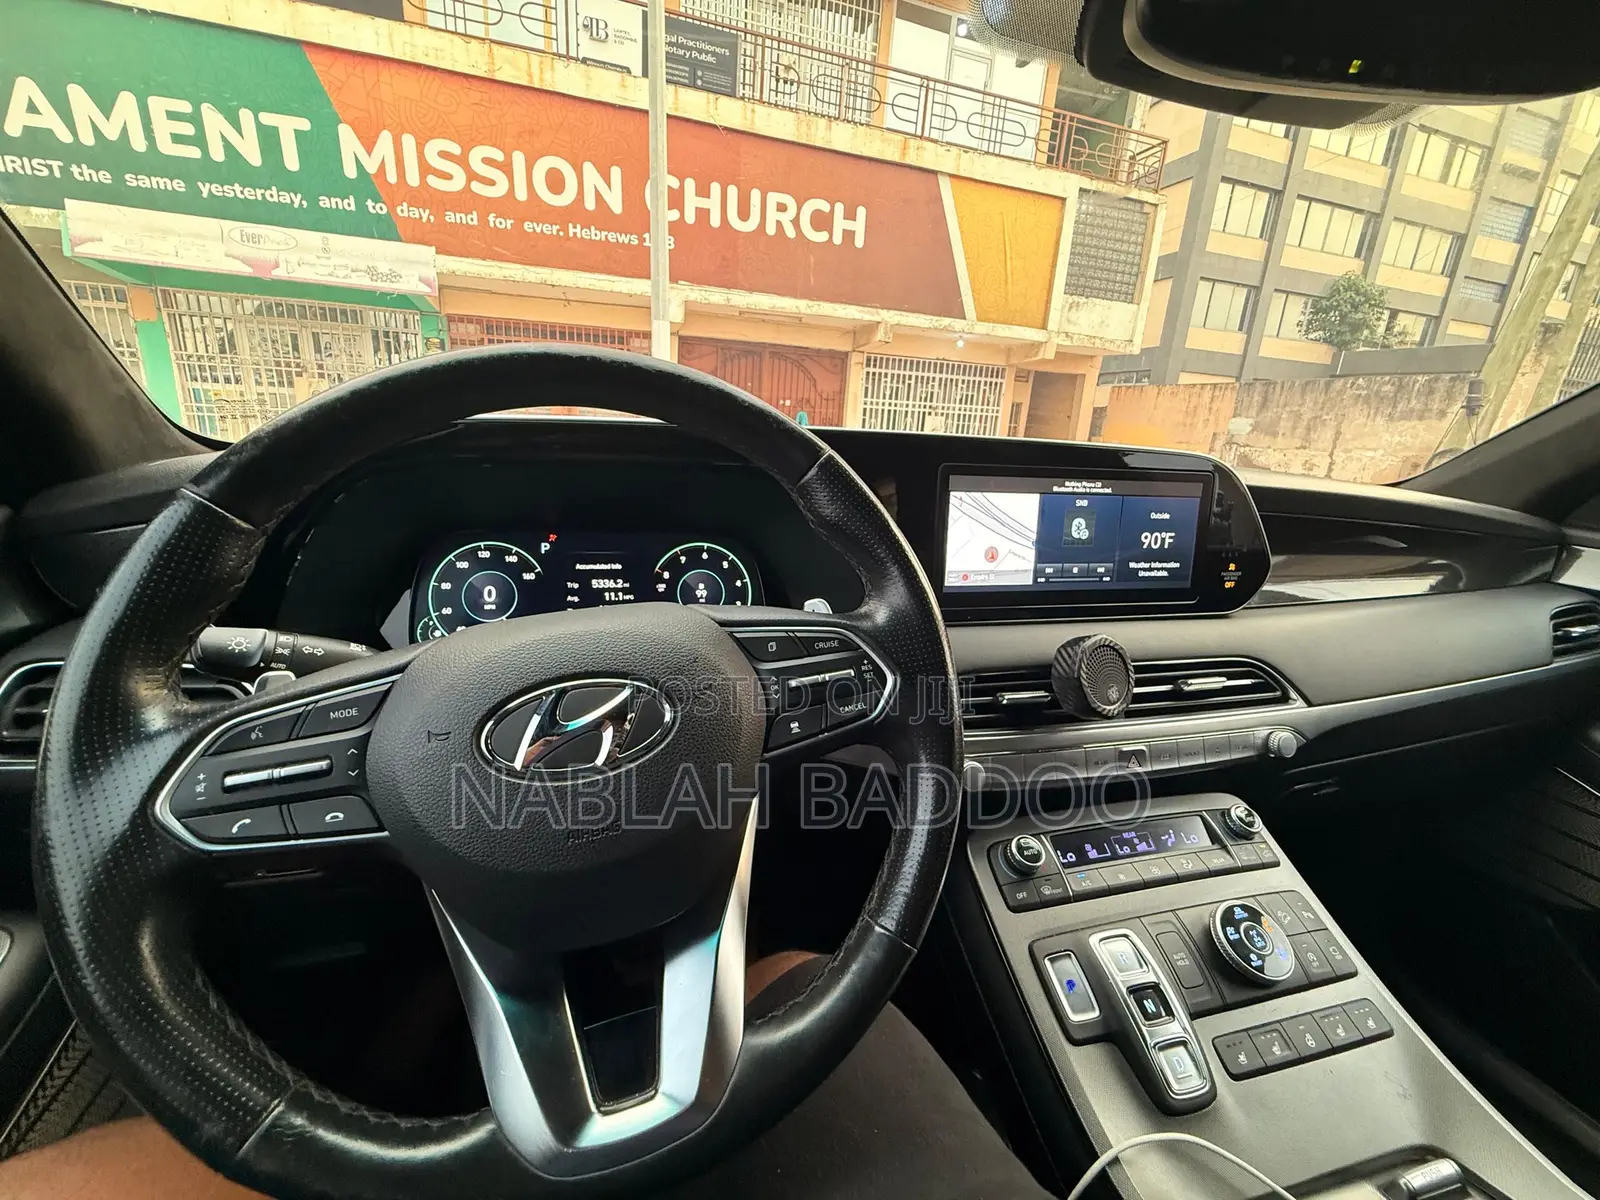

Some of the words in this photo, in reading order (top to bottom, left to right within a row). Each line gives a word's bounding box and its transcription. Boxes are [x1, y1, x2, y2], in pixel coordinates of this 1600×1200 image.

[678, 36, 730, 56] Practitioners
[692, 50, 717, 63] Public
[3, 75, 312, 172] AMENT
[337, 122, 623, 215] MISSION
[644, 173, 867, 249] CHURCH
[69, 163, 113, 184] the
[124, 172, 187, 192] same
[197, 181, 308, 208] yesterday,
[318, 195, 356, 211] and
[365, 198, 388, 215] to
[396, 201, 435, 223] day,
[444, 210, 479, 226] and
[487, 213, 514, 230] for
[523, 220, 564, 237] ever.
[568, 222, 639, 245] Hebrews
[1150, 512, 1171, 520] Outside
[1140, 531, 1176, 549] 90°F
[541, 542, 551, 554] P
[504, 555, 518, 563] 140
[680, 556, 687, 564] 7
[701, 551, 709, 560] 6
[455, 561, 469, 569] 100
[722, 560, 729, 569] 5
[522, 572, 536, 580] 160
[663, 571, 670, 580] 8
[1138, 569, 1169, 577] Unavailable.
[440, 582, 452, 590] 80
[591, 578, 624, 588] 5336.2
[735, 579, 742, 588] 4
[483, 585, 497, 602] 0
[604, 592, 624, 601] 11.1
[441, 607, 453, 615] 60
[814, 639, 840, 650] CRUISE
[269, 662, 287, 670] AUTO
[839, 702, 868, 714] CANCEL
[329, 707, 359, 720] MODE
[1180, 831, 1199, 844] Lo
[1023, 848, 1038, 856] AUTO
[1116, 843, 1131, 854] Lo
[1057, 850, 1077, 863] Lo
[1081, 879, 1093, 887] A/C
[1016, 891, 1028, 900] OFF
[1117, 952, 1129, 965] R
[1173, 952, 1186, 960] AUTO
[1176, 958, 1190, 966] HOLD
[1065, 978, 1076, 993] P
[1143, 998, 1157, 1014] N
[1172, 1056, 1185, 1072] D
